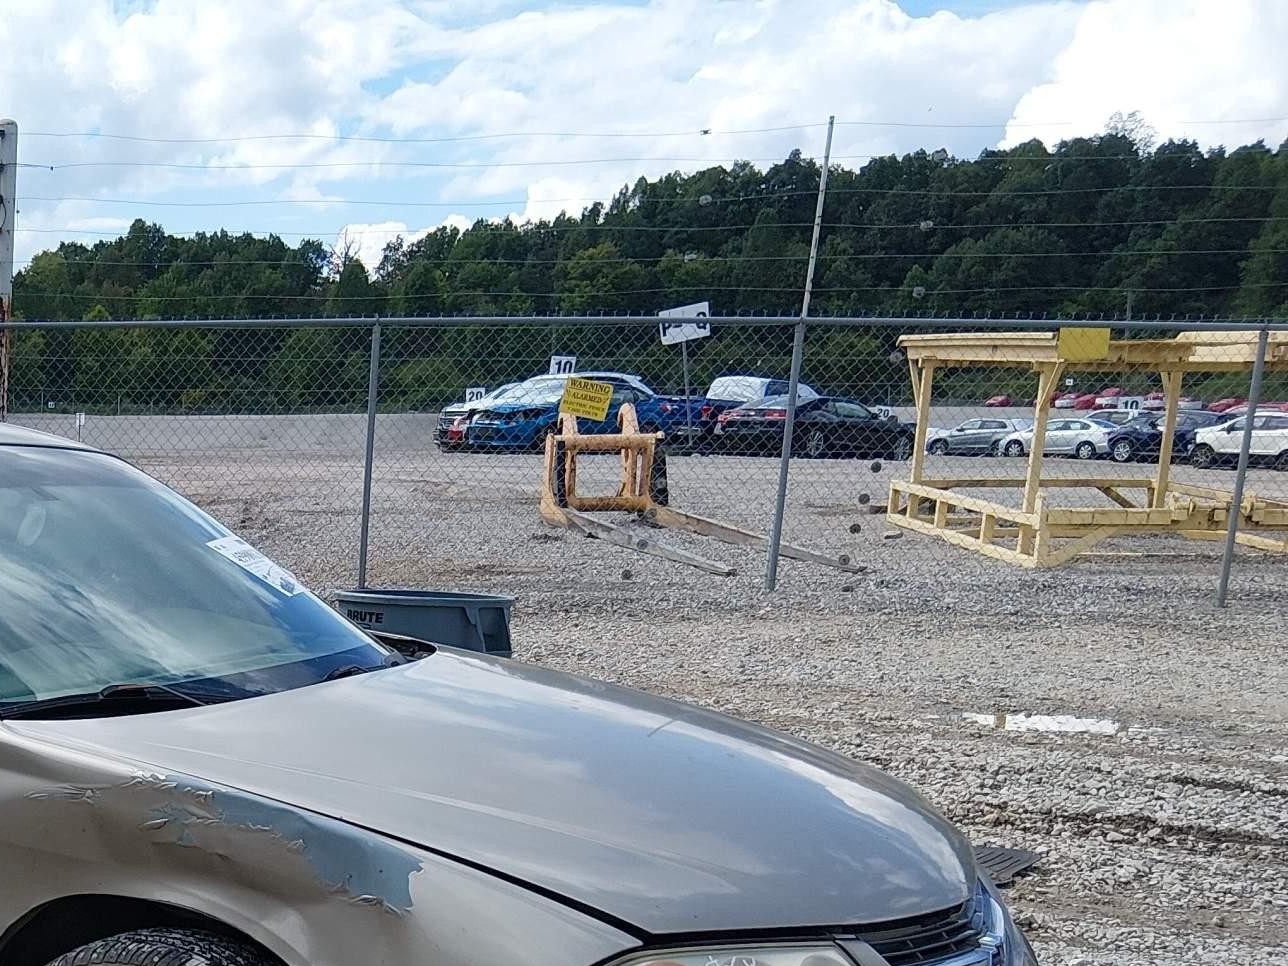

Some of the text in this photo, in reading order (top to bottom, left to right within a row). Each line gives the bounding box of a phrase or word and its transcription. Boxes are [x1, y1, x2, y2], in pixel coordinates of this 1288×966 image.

[554, 360, 573, 374] 10
[569, 378, 611, 393] WARNING
[467, 390, 483, 401] 20
[572, 391, 603, 403] ALARMED
[1122, 399, 1140, 410] 10
[877, 408, 890, 418] 20
[347, 609, 384, 624] BRUTE
